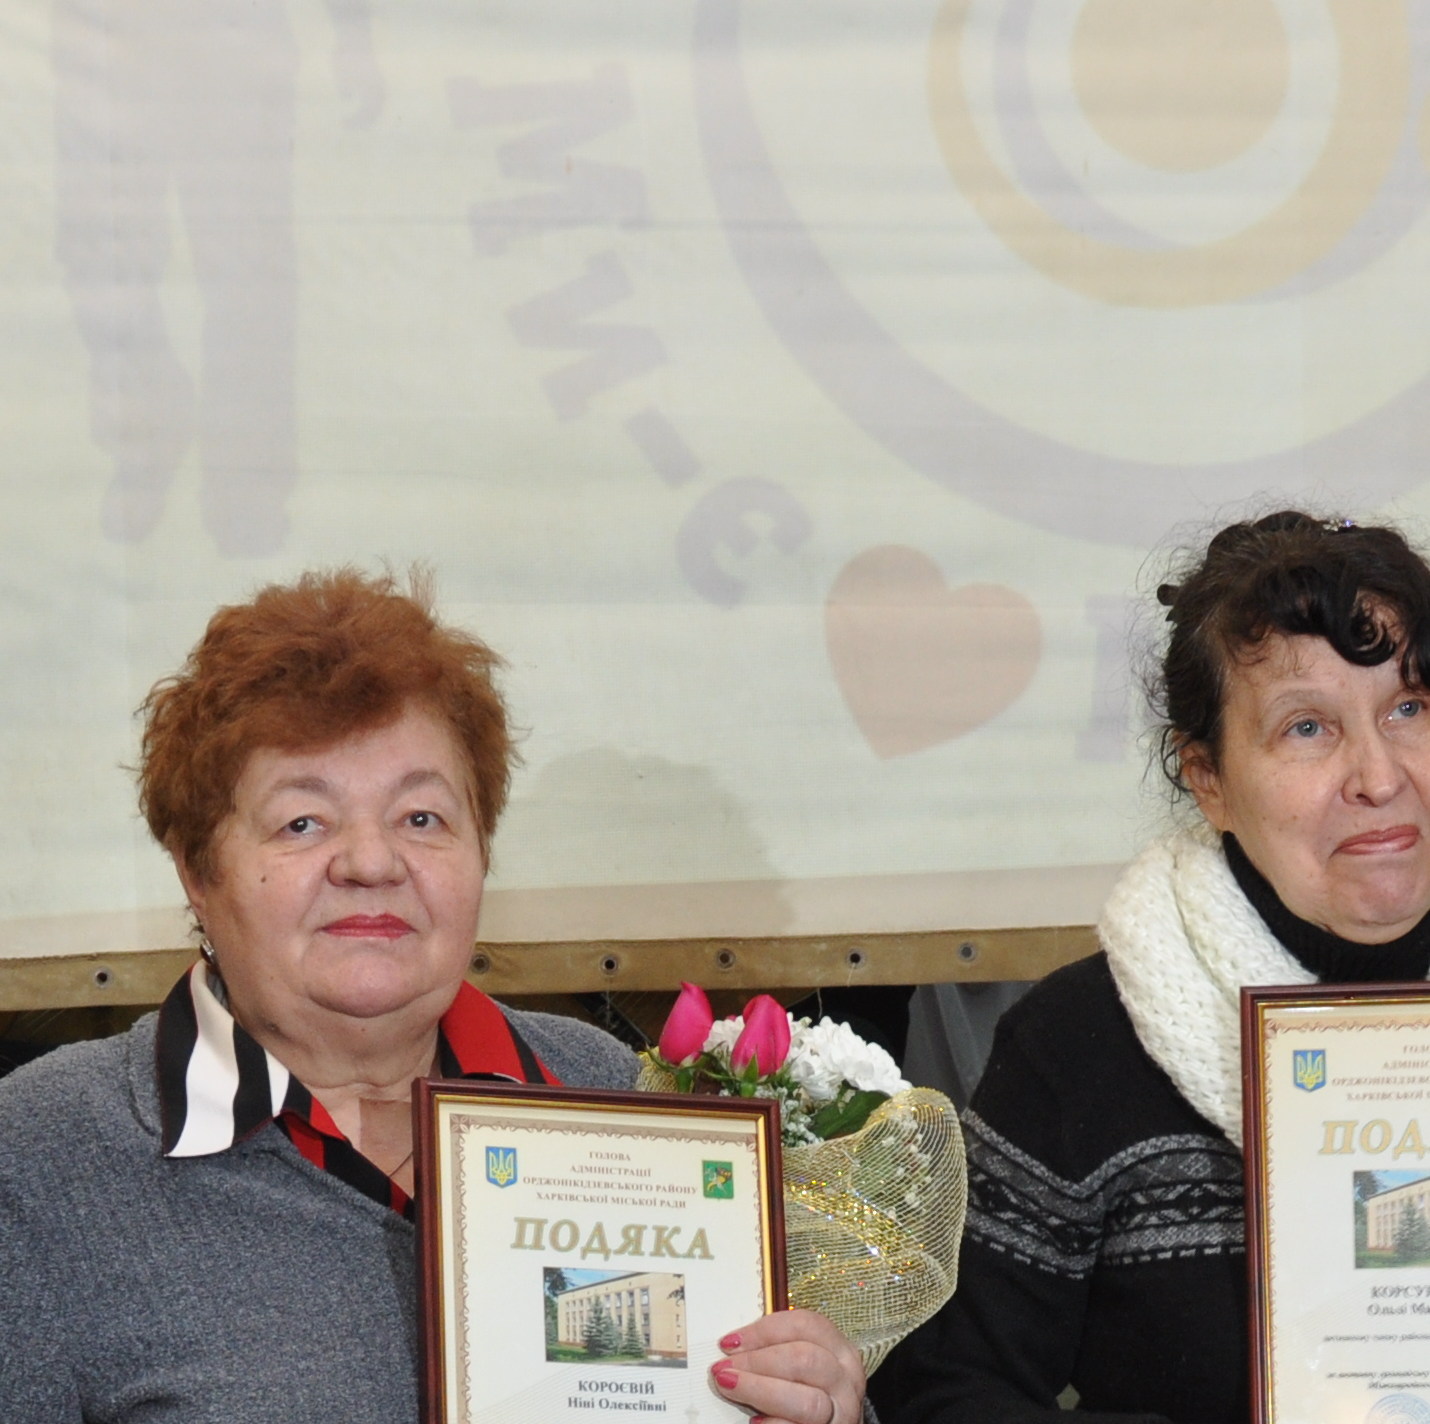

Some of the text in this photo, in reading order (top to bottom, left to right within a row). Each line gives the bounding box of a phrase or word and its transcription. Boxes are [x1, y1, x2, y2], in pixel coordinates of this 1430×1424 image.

[589, 1151, 631, 1161] ГОЛОВА
[570, 1165, 651, 1177] АДМІНІСТРАЦІЇ
[523, 1176, 698, 1195] ОРДЖОНІКІДЗЕВСЬКОГО РАЙОНУ
[536, 1192, 686, 1208] ХАРКІВСЬКОЇ МІСЬКОЇ РАДИ
[510, 1216, 715, 1262] ПОДЯКА
[578, 1380, 655, 1395] КОРОЄВІЙ
